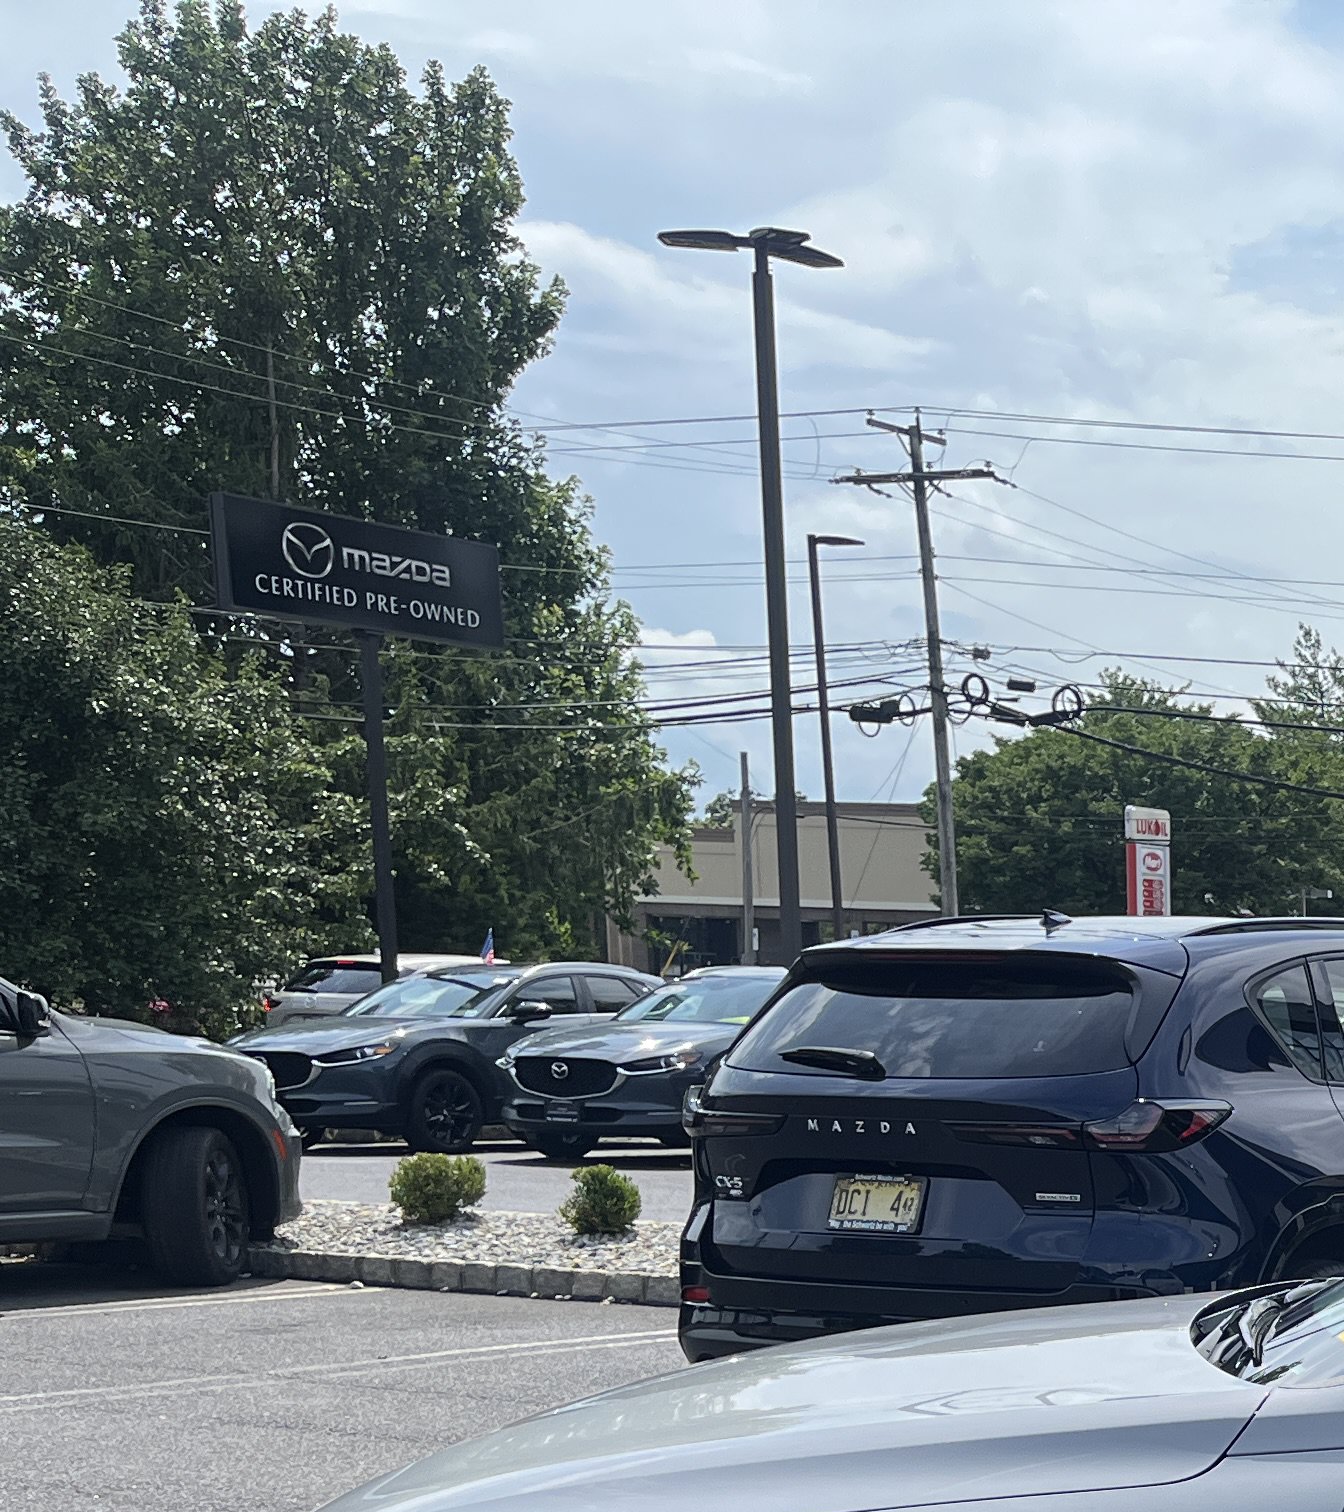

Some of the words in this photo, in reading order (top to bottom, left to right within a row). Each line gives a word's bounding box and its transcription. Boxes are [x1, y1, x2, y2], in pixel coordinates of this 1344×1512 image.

[254, 573, 357, 608] CERTIFIED
[366, 591, 480, 629] PRE-OWNED
[807, 1118, 916, 1135] MAZDA
[715, 1175, 743, 1188] CX-5
